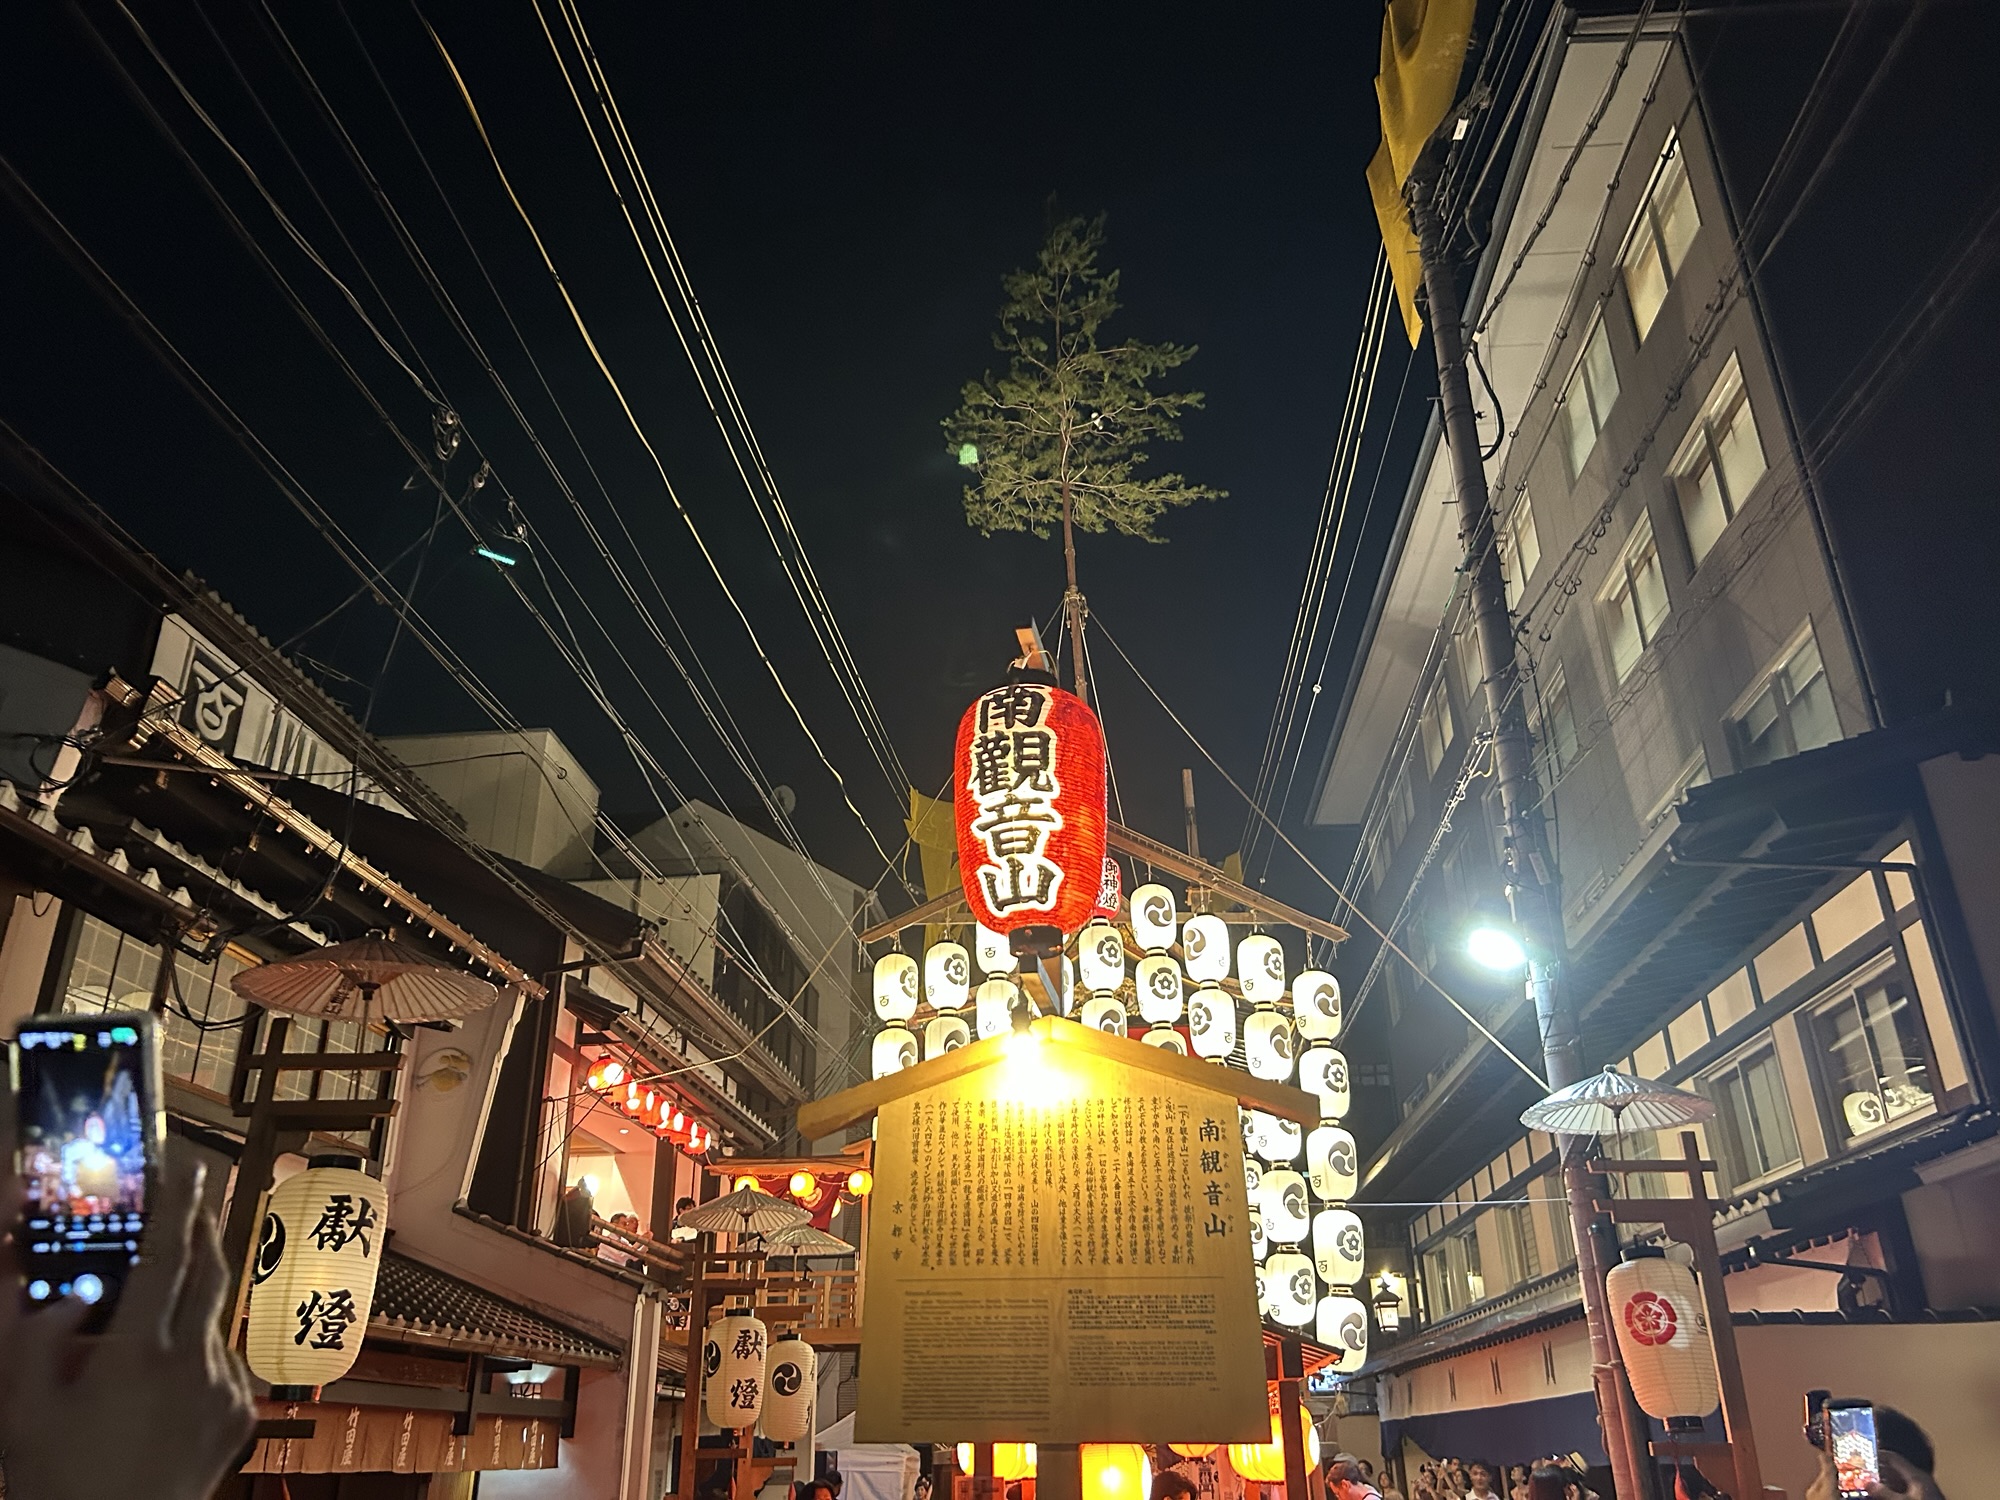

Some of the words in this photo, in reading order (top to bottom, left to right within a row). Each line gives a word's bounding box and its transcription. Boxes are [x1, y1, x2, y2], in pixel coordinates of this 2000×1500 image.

[971, 684, 1057, 912] 南觀音山
[1103, 860, 1118, 910] 御神燈
[1199, 1117, 1227, 1238] 南観音山
[891, 1200, 903, 1261] 京都市
